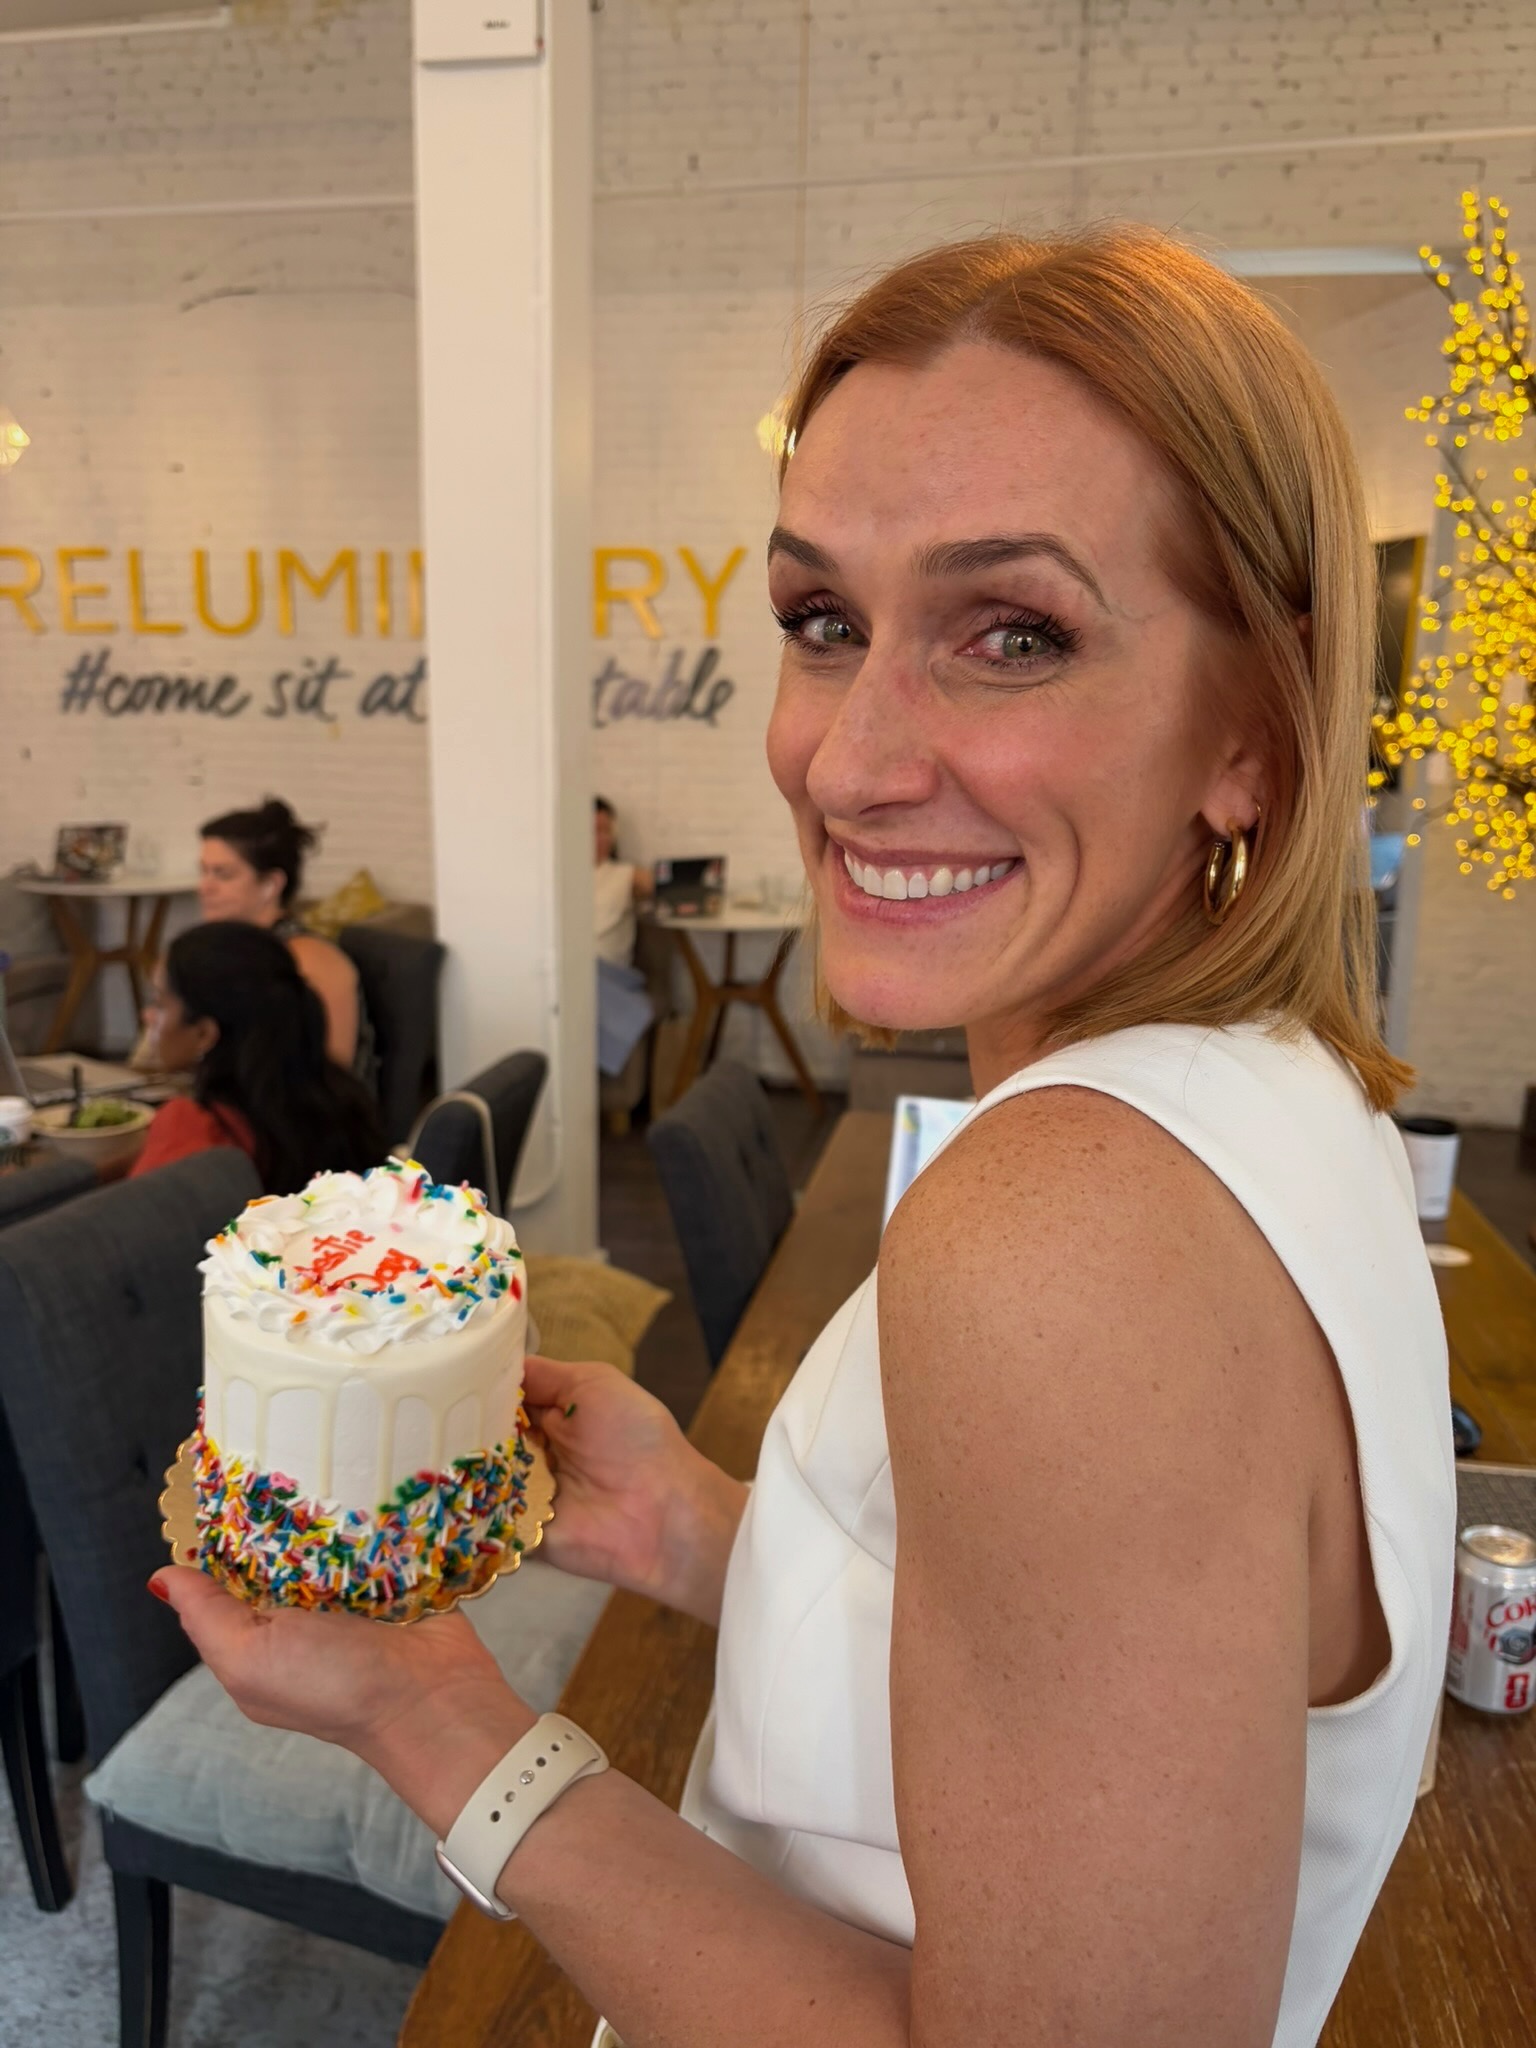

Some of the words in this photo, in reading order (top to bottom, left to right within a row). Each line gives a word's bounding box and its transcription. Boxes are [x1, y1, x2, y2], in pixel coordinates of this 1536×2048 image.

[62, 648, 251, 717] #come
[264, 655, 353, 722] sit
[359, 656, 428, 723] at
[591, 647, 736, 730] table
[1484, 1595, 1536, 1629] Cok
